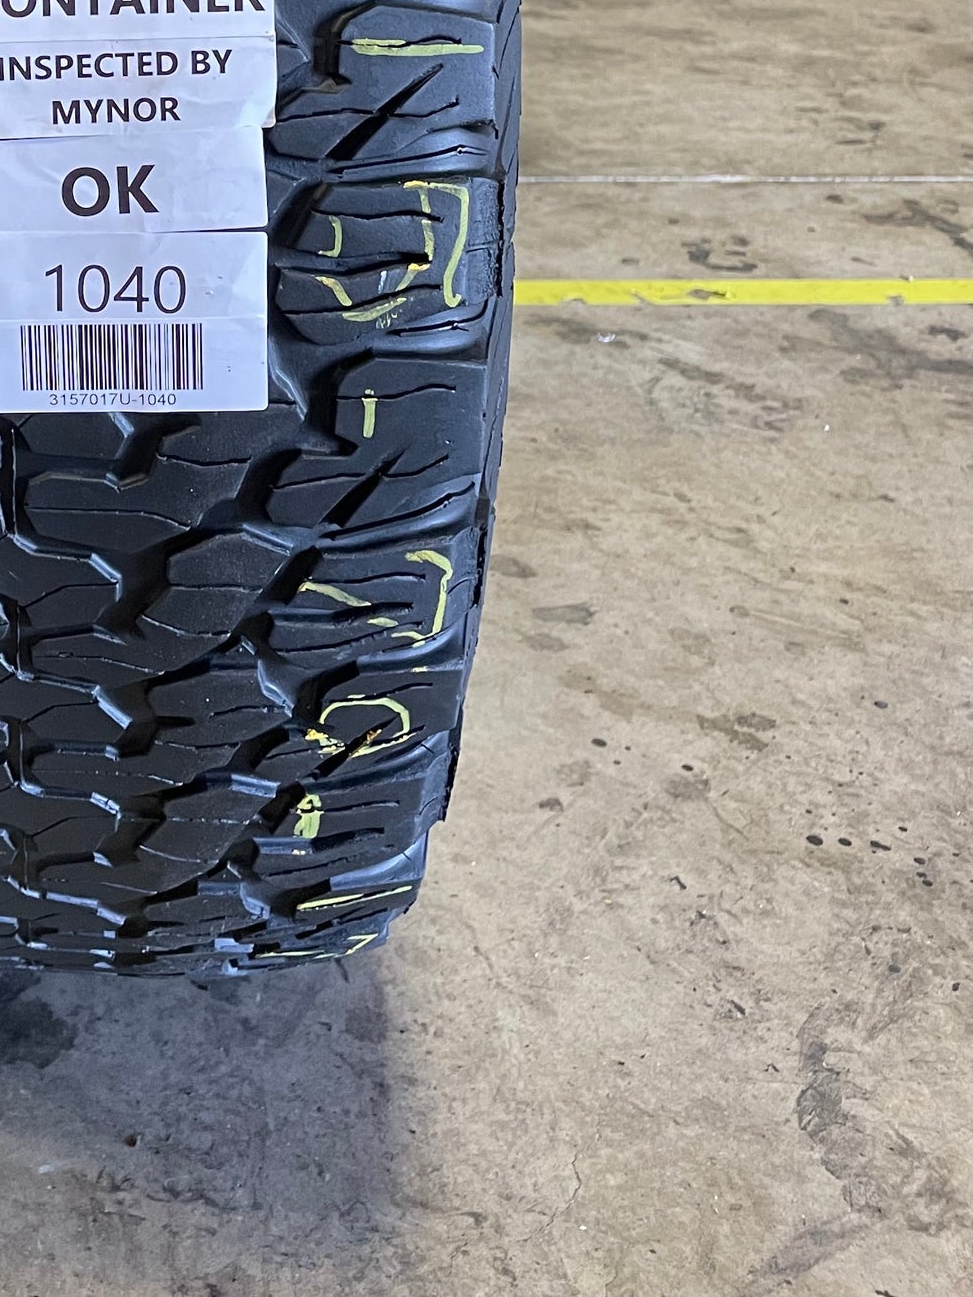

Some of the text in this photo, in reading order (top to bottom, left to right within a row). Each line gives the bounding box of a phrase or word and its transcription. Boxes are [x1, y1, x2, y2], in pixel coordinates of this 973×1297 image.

[190, 49, 233, 75] BY
[51, 97, 181, 125] MYNOR
[61, 164, 159, 217] OK
[44, 264, 187, 314] 1040
[49, 393, 178, 407] 3157017U-1040
